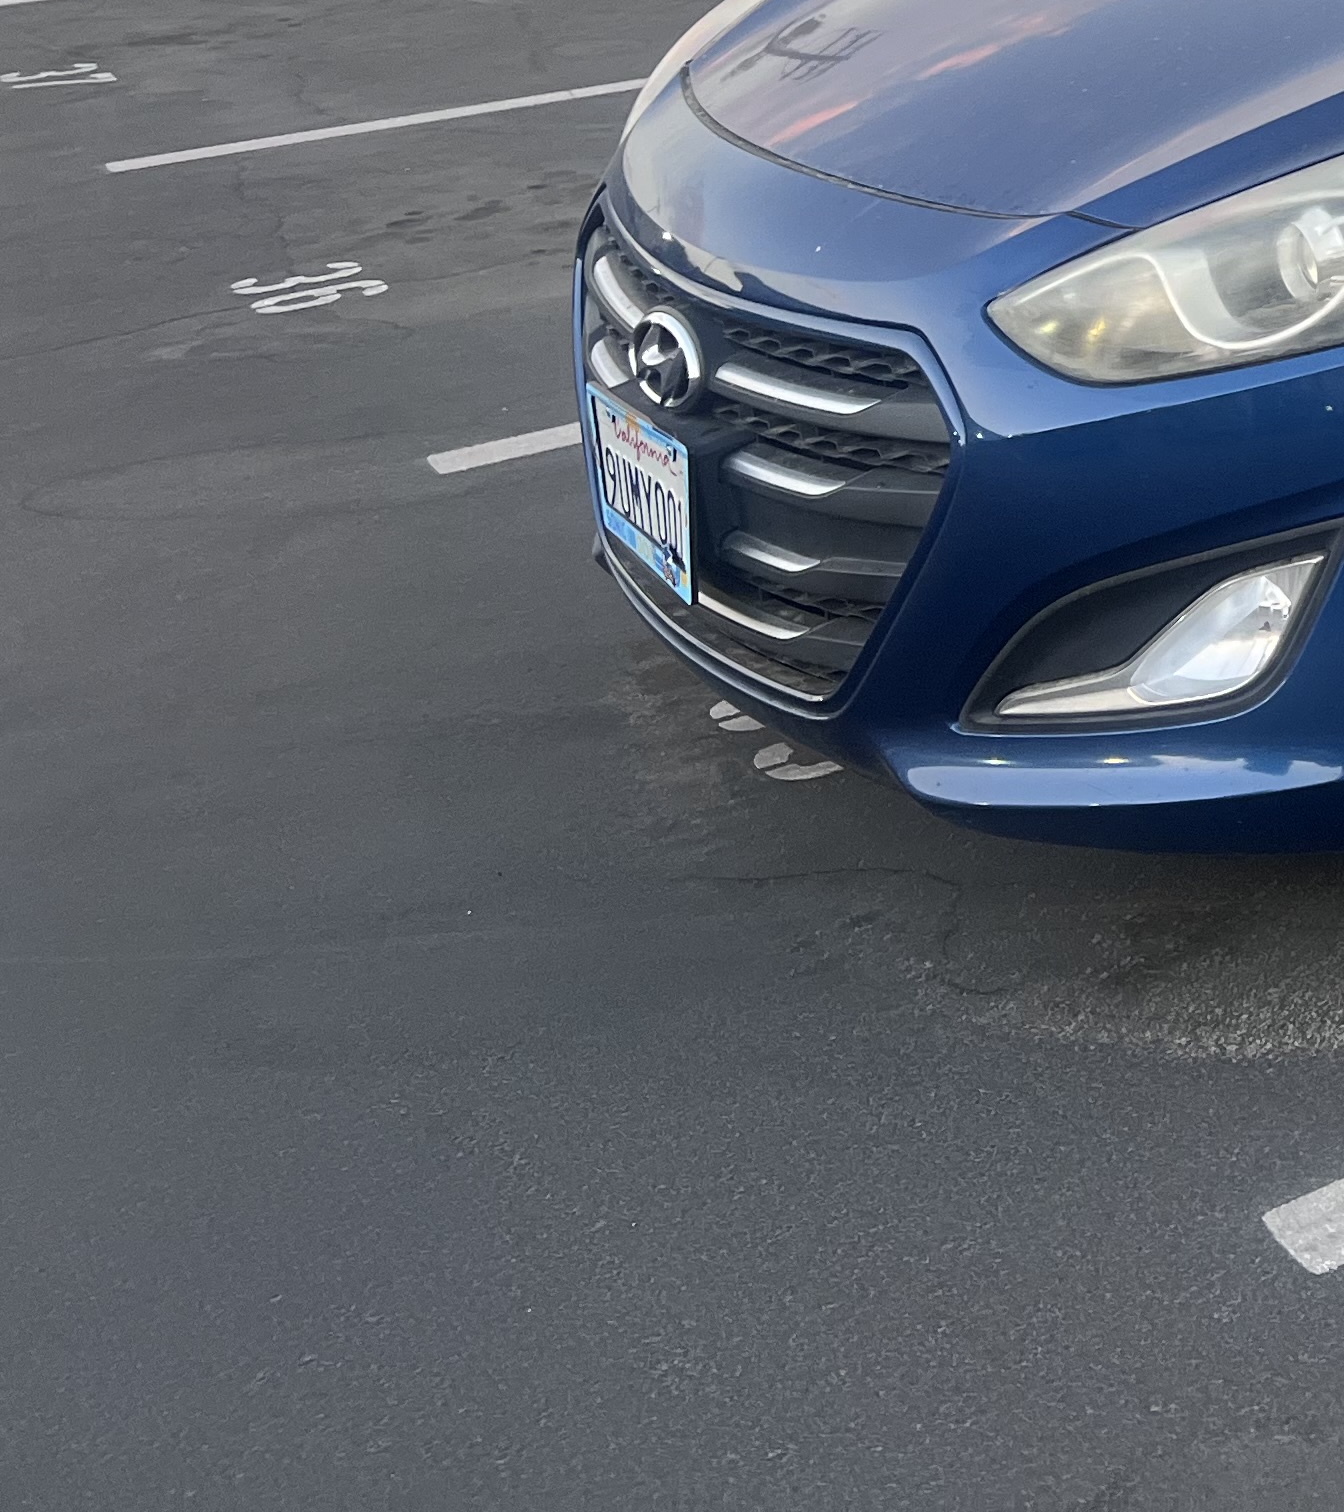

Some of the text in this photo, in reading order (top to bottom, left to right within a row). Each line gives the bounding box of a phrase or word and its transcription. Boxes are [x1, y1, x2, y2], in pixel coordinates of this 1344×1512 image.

[230, 261, 389, 314] 36
[613, 420, 678, 477] California
[605, 446, 684, 559] 9UMY001
